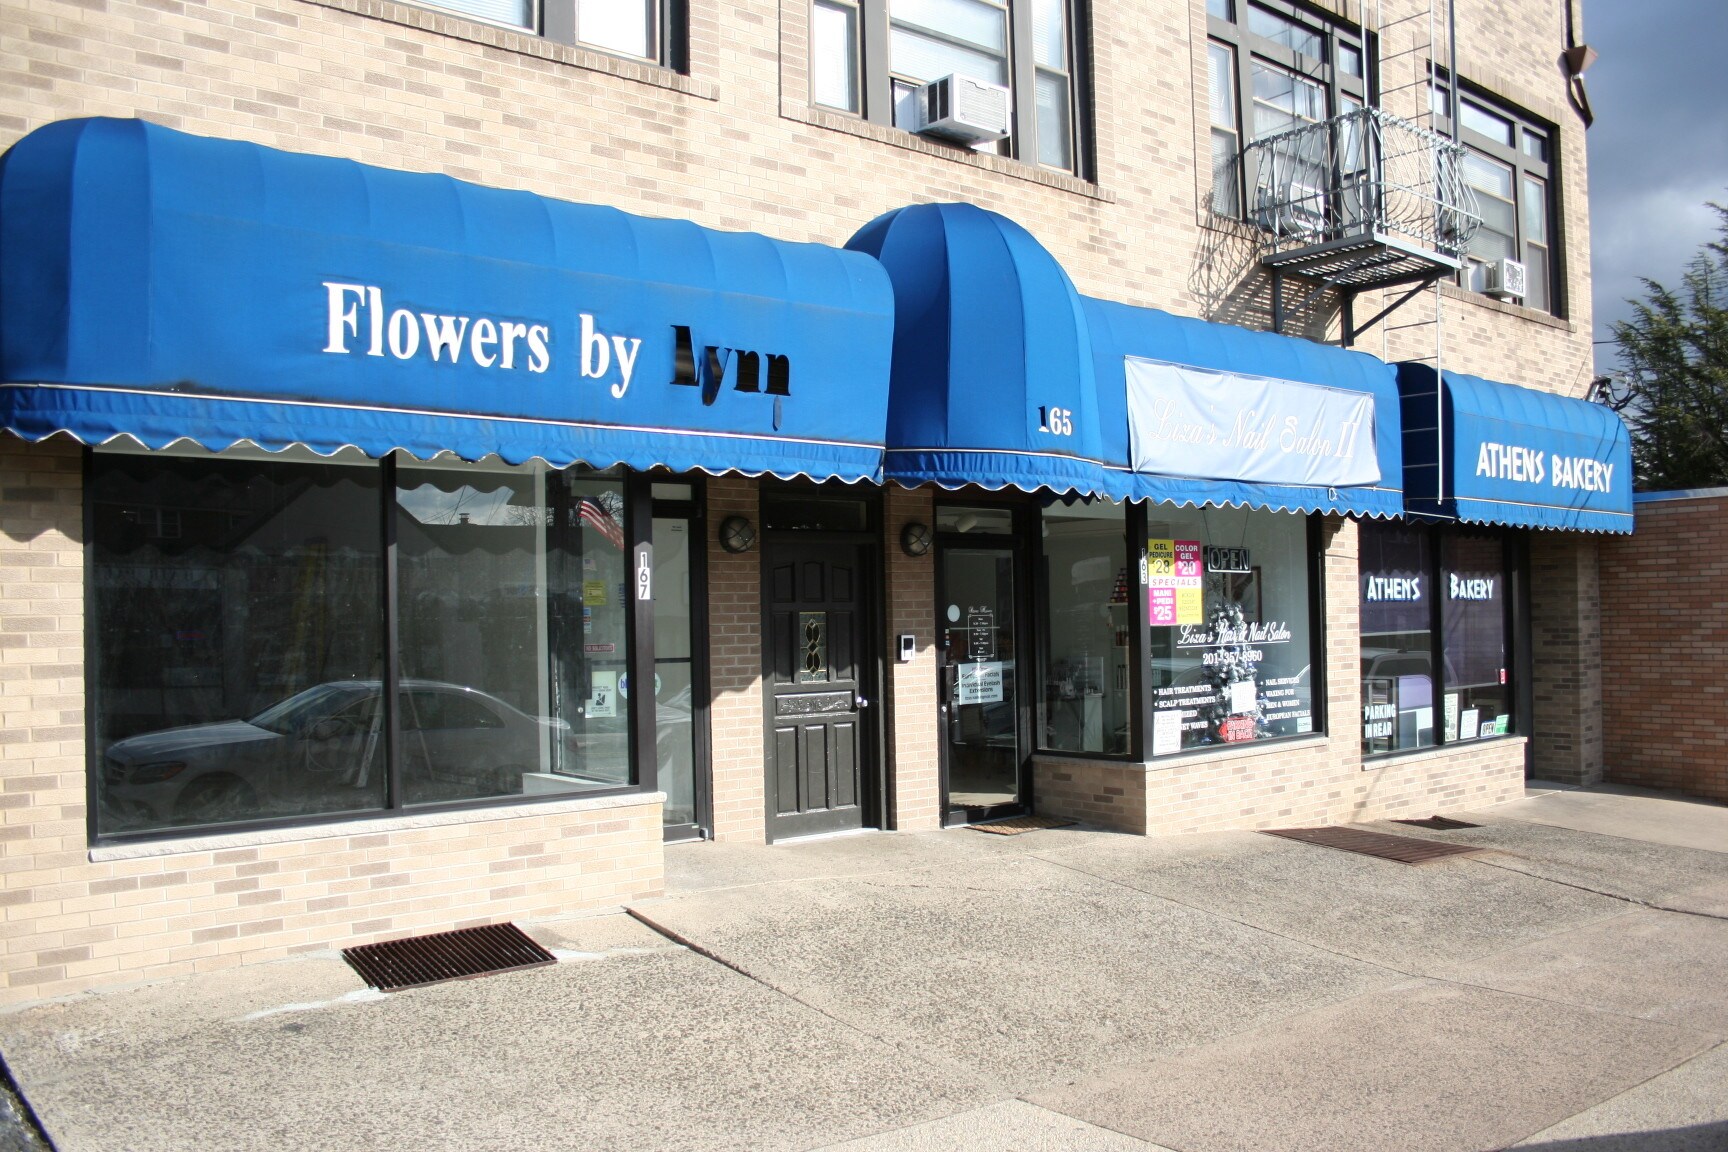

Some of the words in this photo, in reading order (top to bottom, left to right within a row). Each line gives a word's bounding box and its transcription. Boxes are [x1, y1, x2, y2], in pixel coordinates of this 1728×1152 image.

[322, 281, 550, 374] Flowers
[579, 313, 641, 398] by
[1038, 405, 1073, 436] 165
[1149, 398, 1217, 445] Liza's
[1223, 409, 1277, 451] Nail
[1279, 415, 1332, 456] Salon
[1475, 441, 1545, 484] ATHENS
[1551, 454, 1614, 493] BAKERY
[1210, 548, 1249, 570] OPEN
[638, 552, 649, 600] 167
[1152, 578, 1198, 586] SPECIALS
[1367, 575, 1420, 601] ATHENS
[1450, 572, 1494, 599] BAKERY
[1153, 605, 1173, 620] $25
[1248, 622, 1269, 642] Nail
[1267, 621, 1291, 641] Salon
[1158, 687, 1174, 696] HAIR
[1174, 684, 1212, 695] TREATMENTS
[1158, 699, 1177, 708] SCALP
[1178, 696, 1216, 706] TREATMENTS
[1364, 703, 1396, 720] PARKING
[1365, 723, 1373, 739] IN
[1373, 721, 1392, 738] REAR
